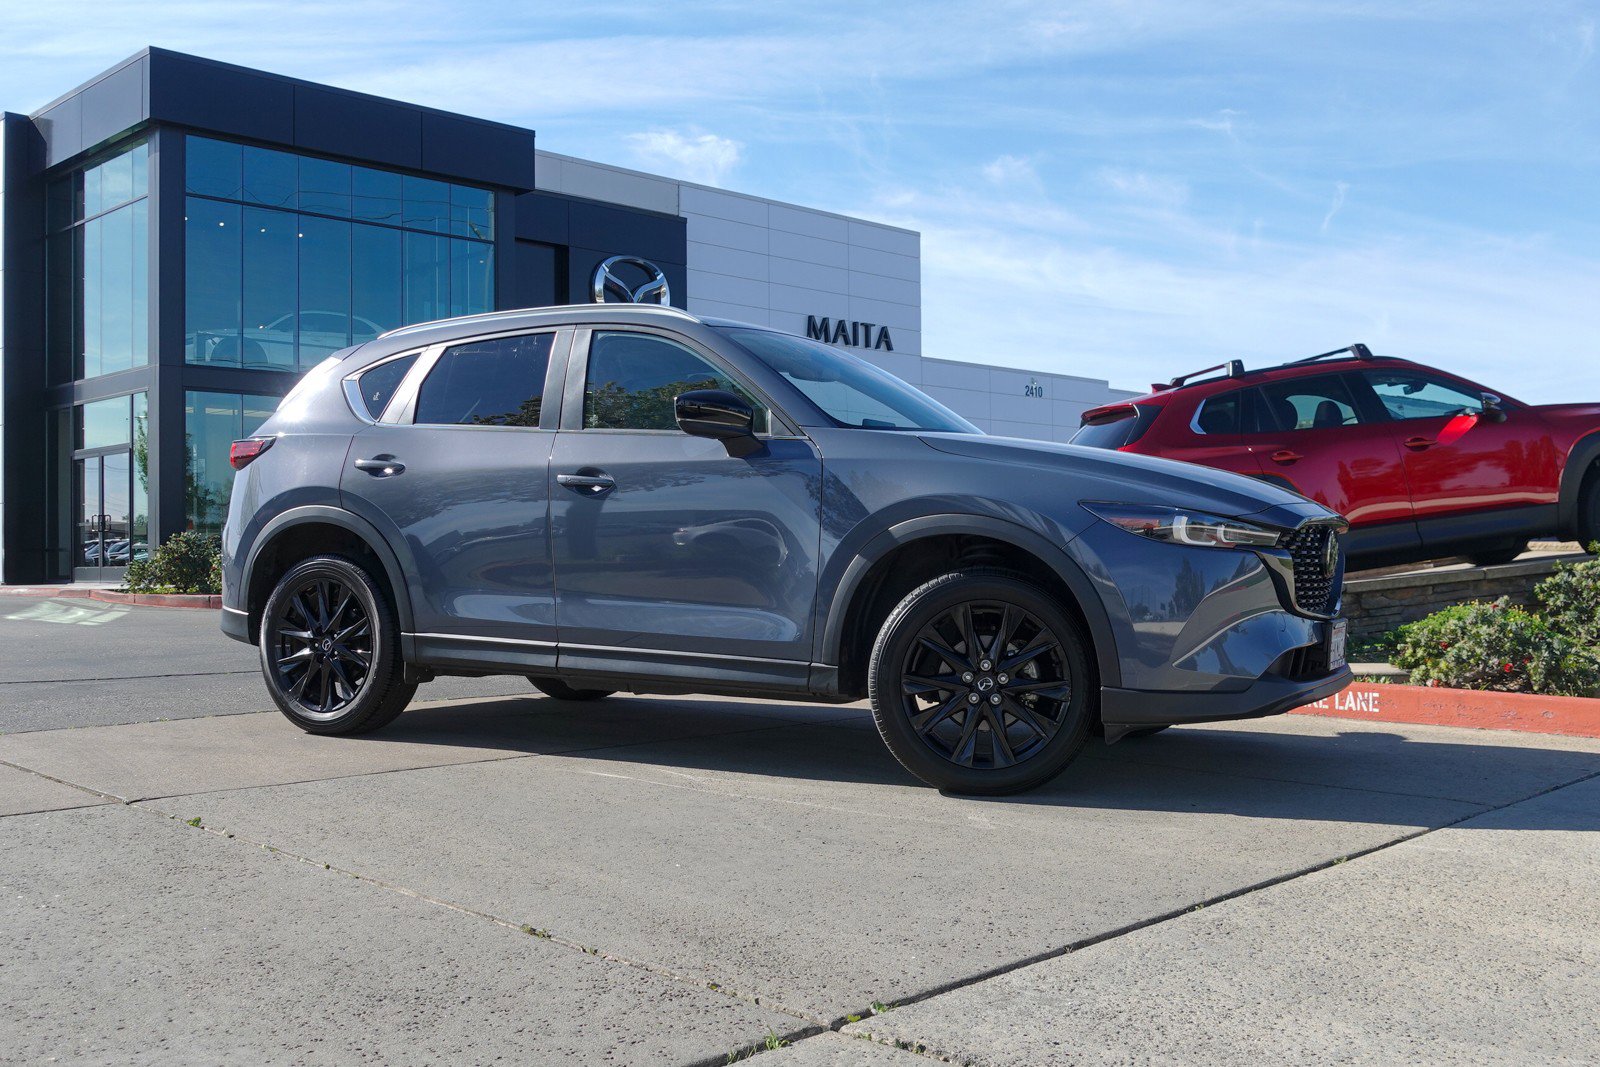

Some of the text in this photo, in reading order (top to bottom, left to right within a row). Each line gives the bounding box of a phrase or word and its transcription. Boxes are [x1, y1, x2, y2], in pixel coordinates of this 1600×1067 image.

[807, 315, 894, 351] MAITA
[1025, 385, 1043, 398] 2410
[1335, 691, 1380, 712] LANE
